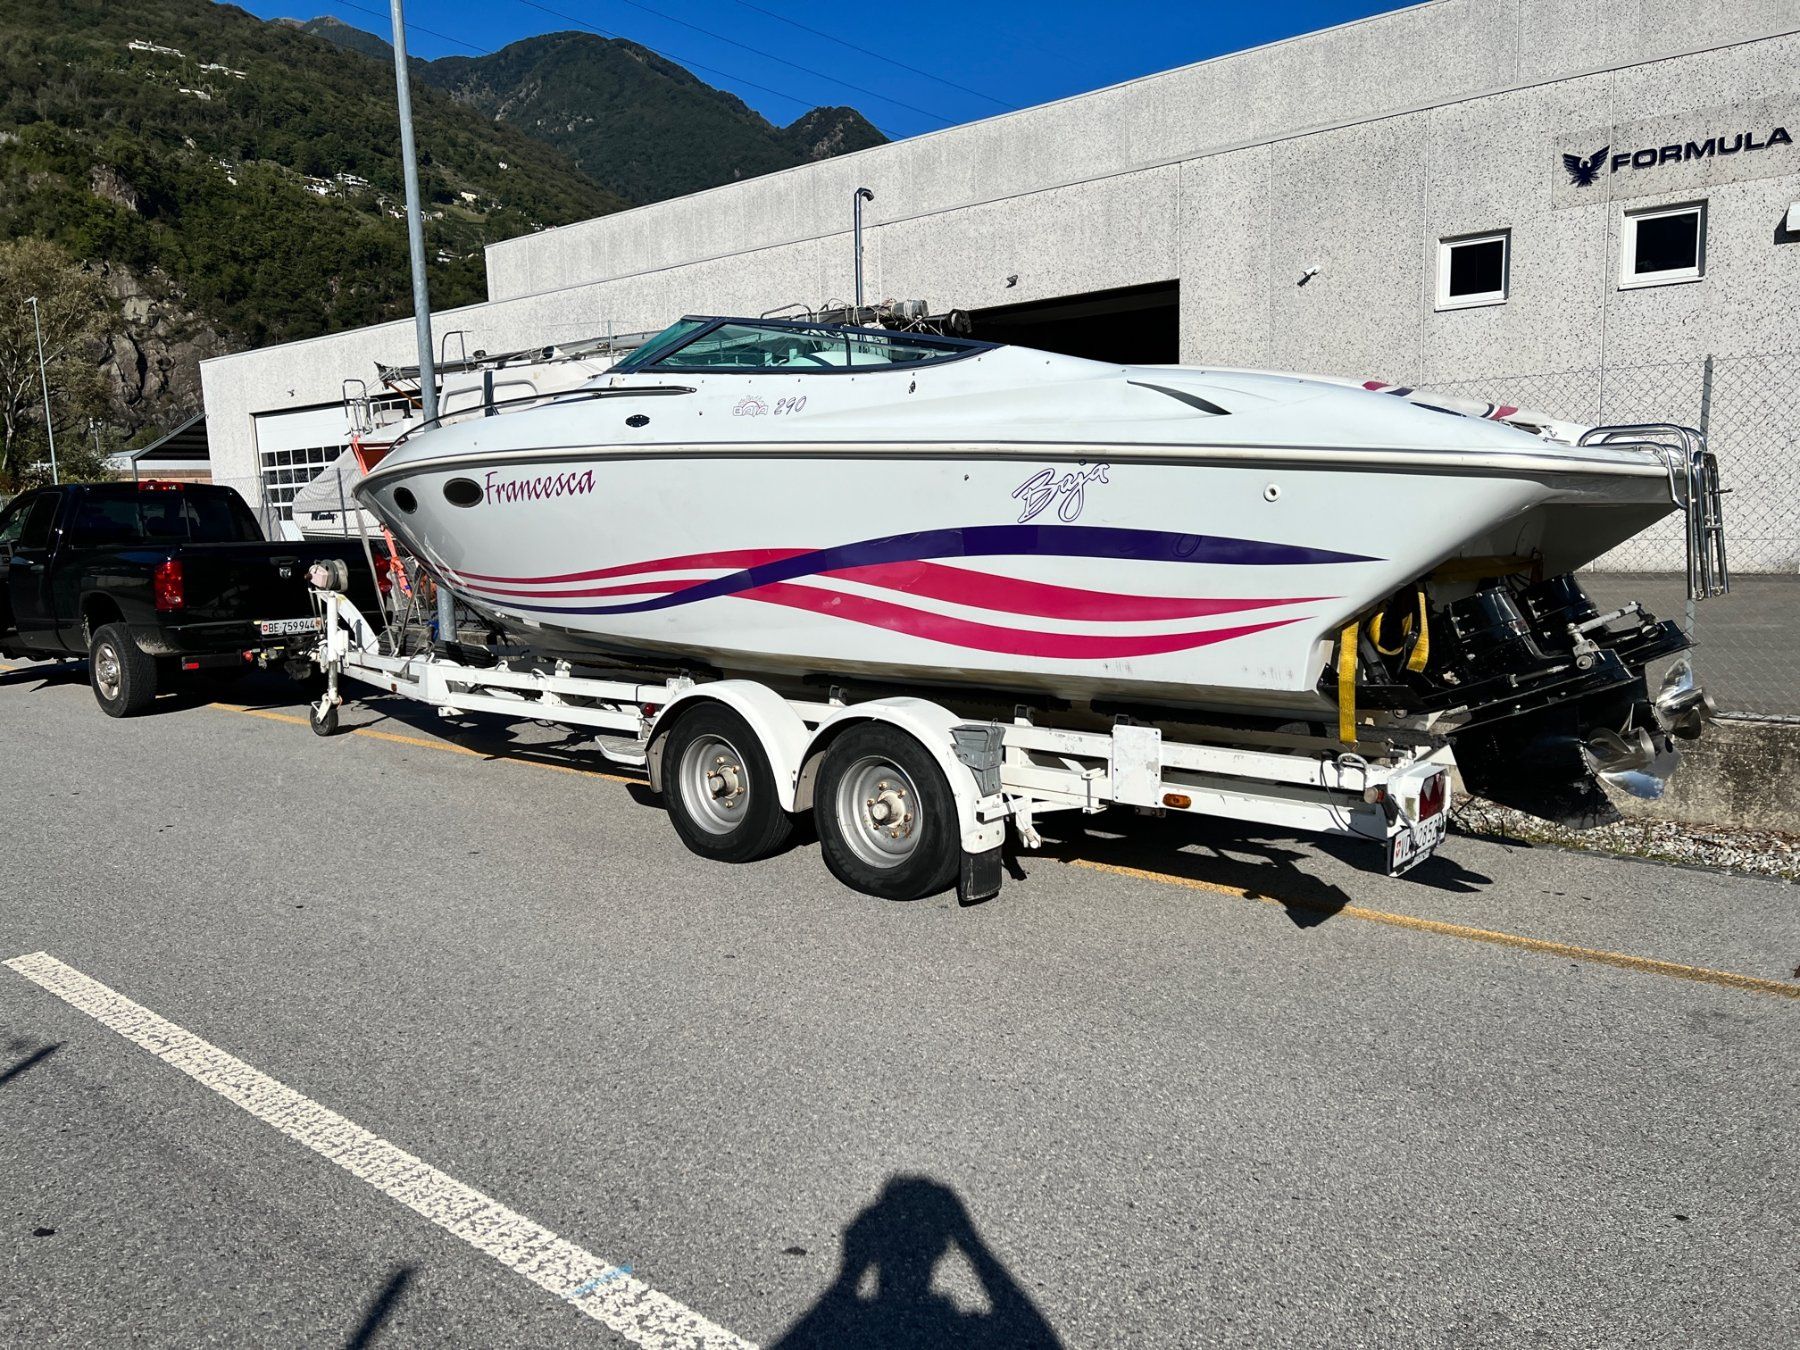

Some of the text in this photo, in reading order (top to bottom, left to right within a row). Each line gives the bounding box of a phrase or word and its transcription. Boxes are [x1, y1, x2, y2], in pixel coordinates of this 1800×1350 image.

[1611, 127, 1793, 174] FORMULA
[774, 396, 807, 415] 290
[485, 469, 596, 505] Francesca
[1011, 459, 1110, 523] Baja
